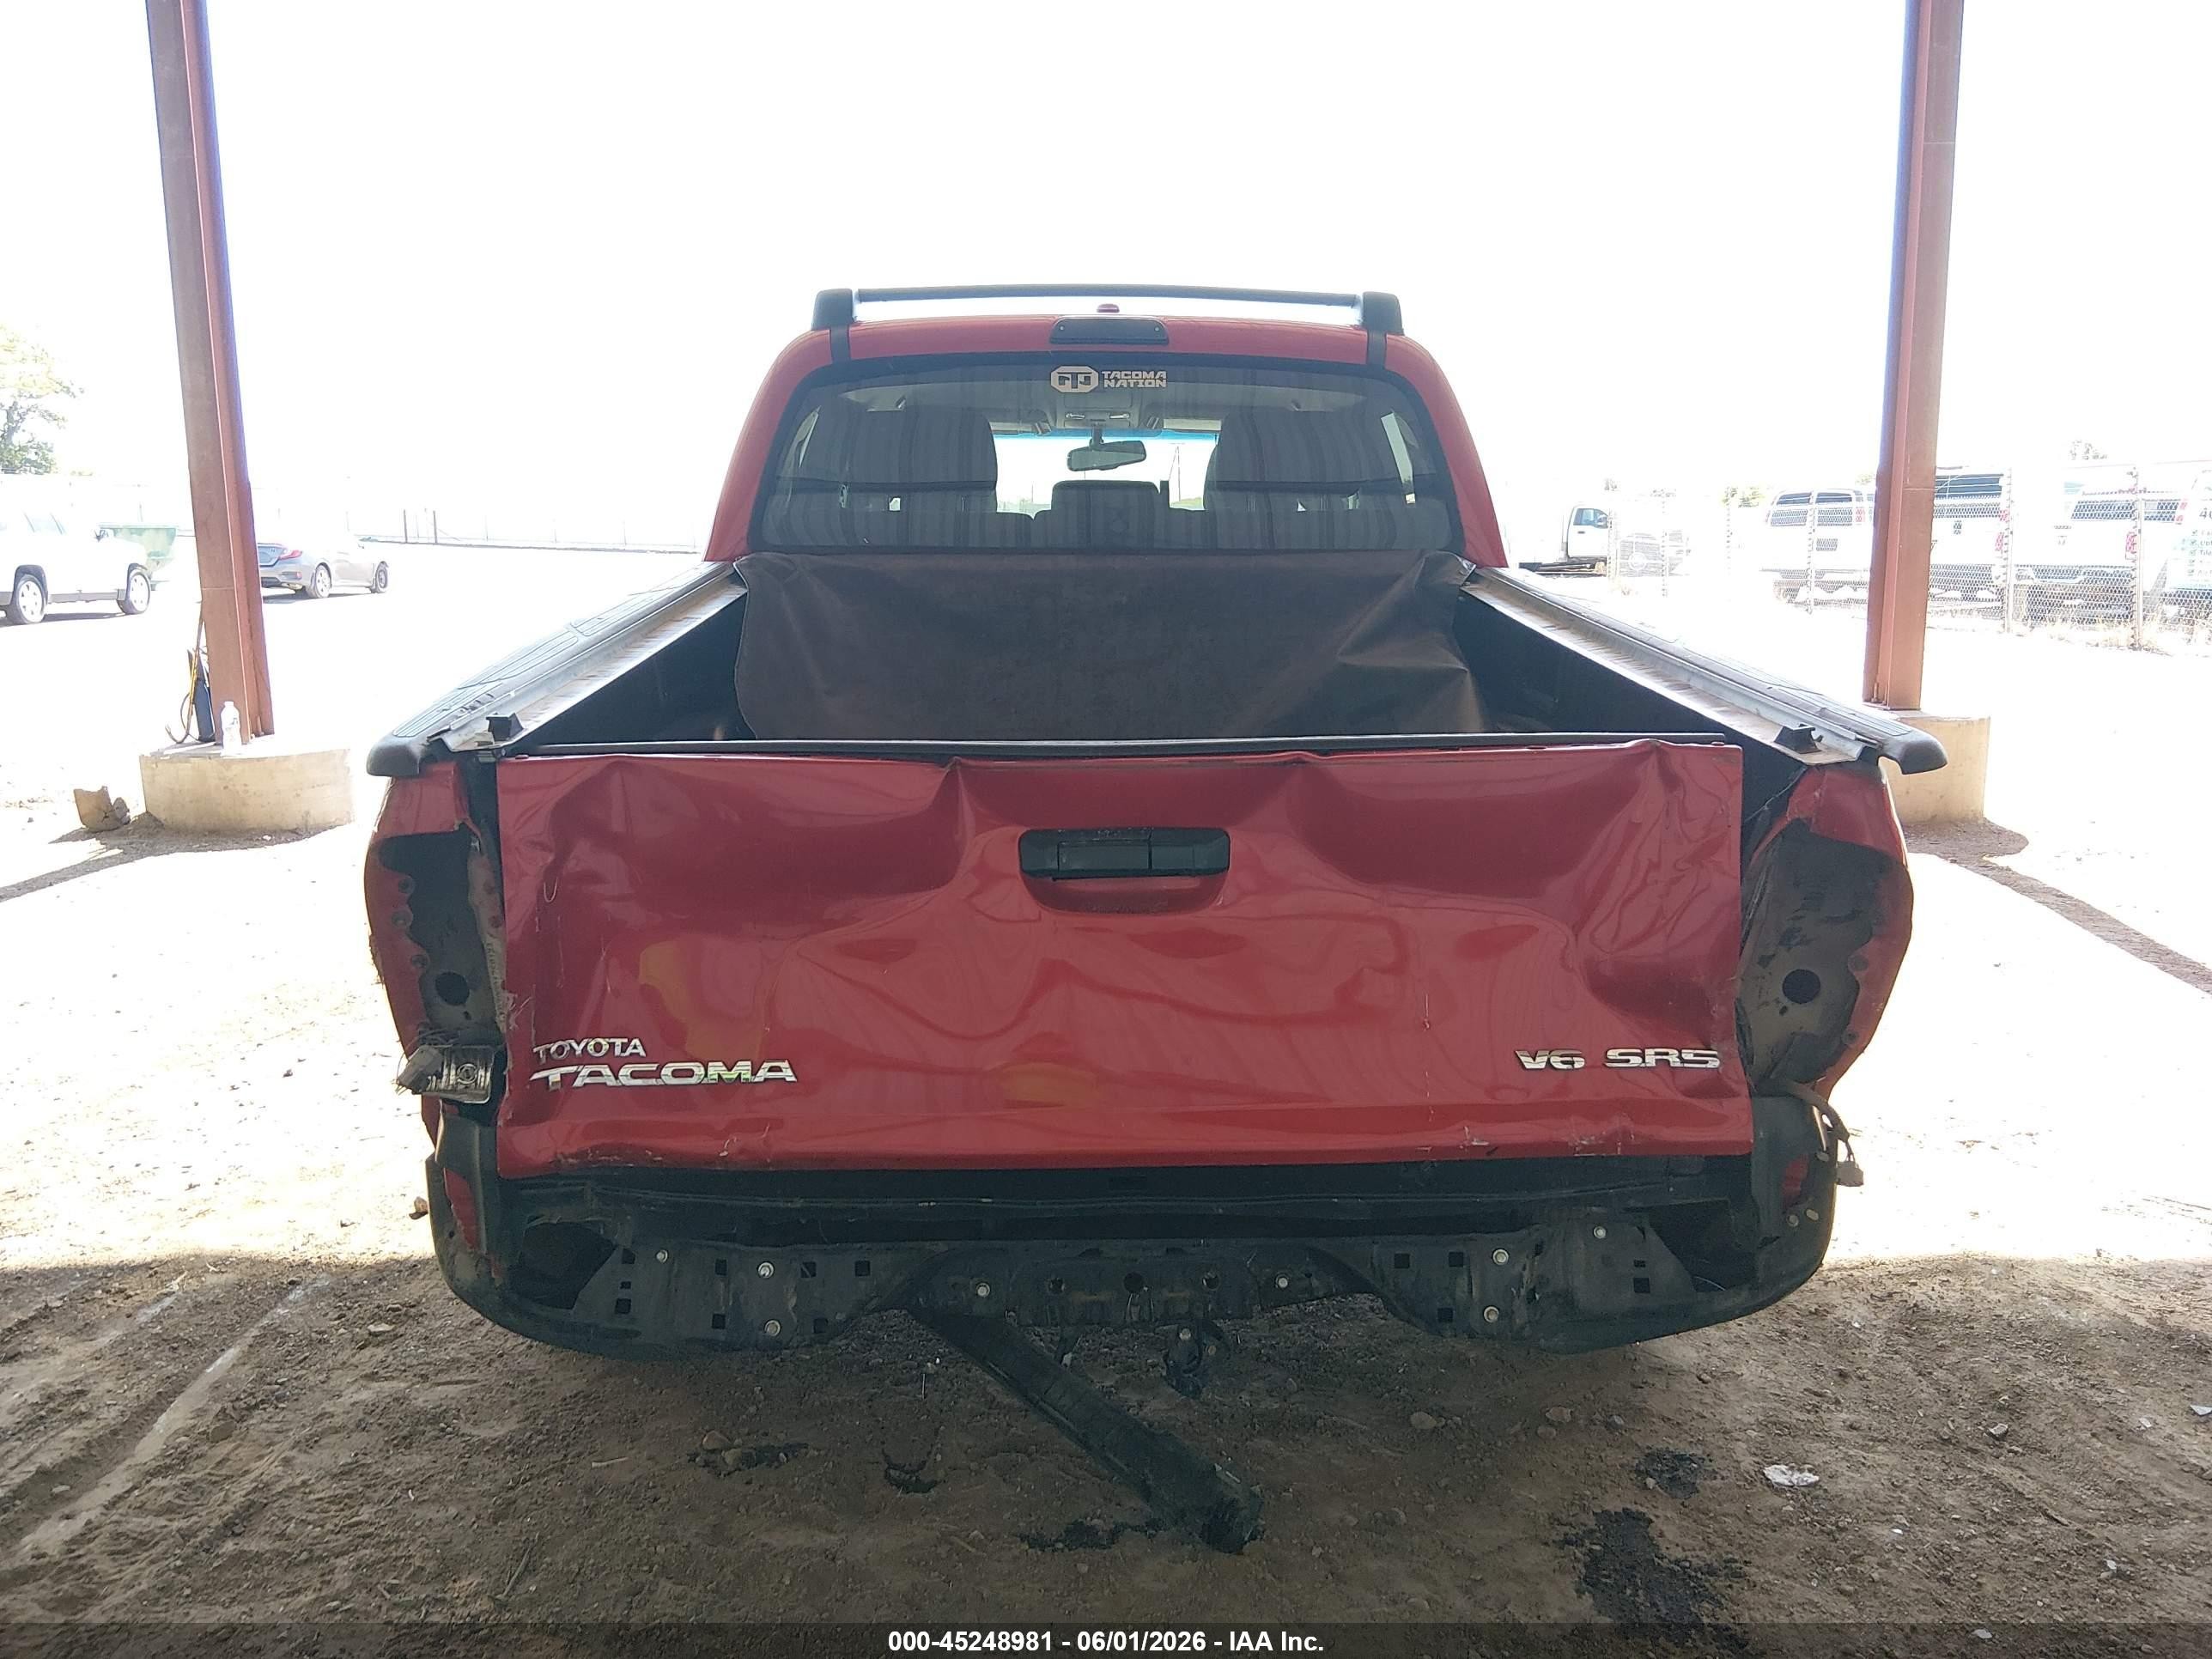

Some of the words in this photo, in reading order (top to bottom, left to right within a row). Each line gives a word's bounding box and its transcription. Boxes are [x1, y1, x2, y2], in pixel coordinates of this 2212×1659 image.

[1102, 370, 1167, 380] TACOMA
[1103, 379, 1167, 388] NATION
[533, 1037, 647, 1064] TOYOTA
[1515, 1049, 1585, 1070] V6
[1603, 1048, 1721, 1069] SR5
[529, 1060, 798, 1091] TACOMA
